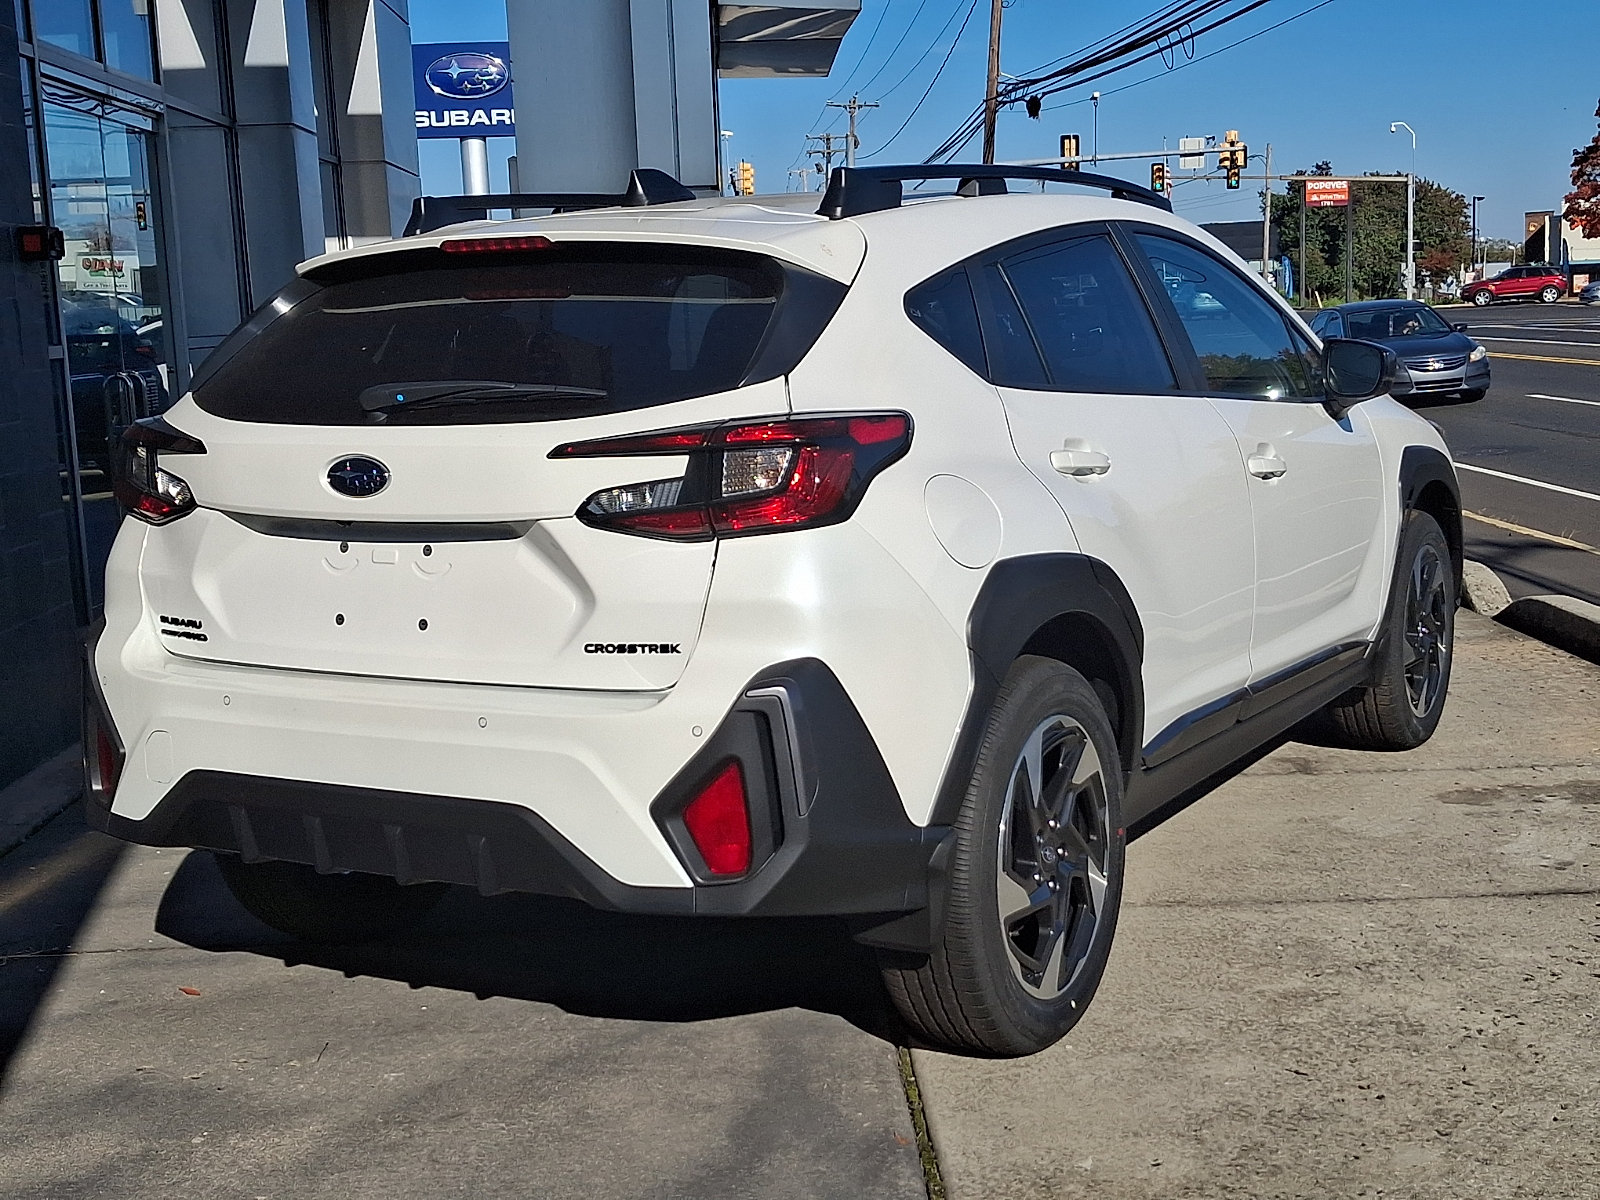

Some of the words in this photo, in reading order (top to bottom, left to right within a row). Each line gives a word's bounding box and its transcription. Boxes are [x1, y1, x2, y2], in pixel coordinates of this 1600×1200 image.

[415, 109, 515, 128] SUBAR
[160, 615, 203, 629] SUBARU
[584, 643, 682, 654] CROSSTREK
